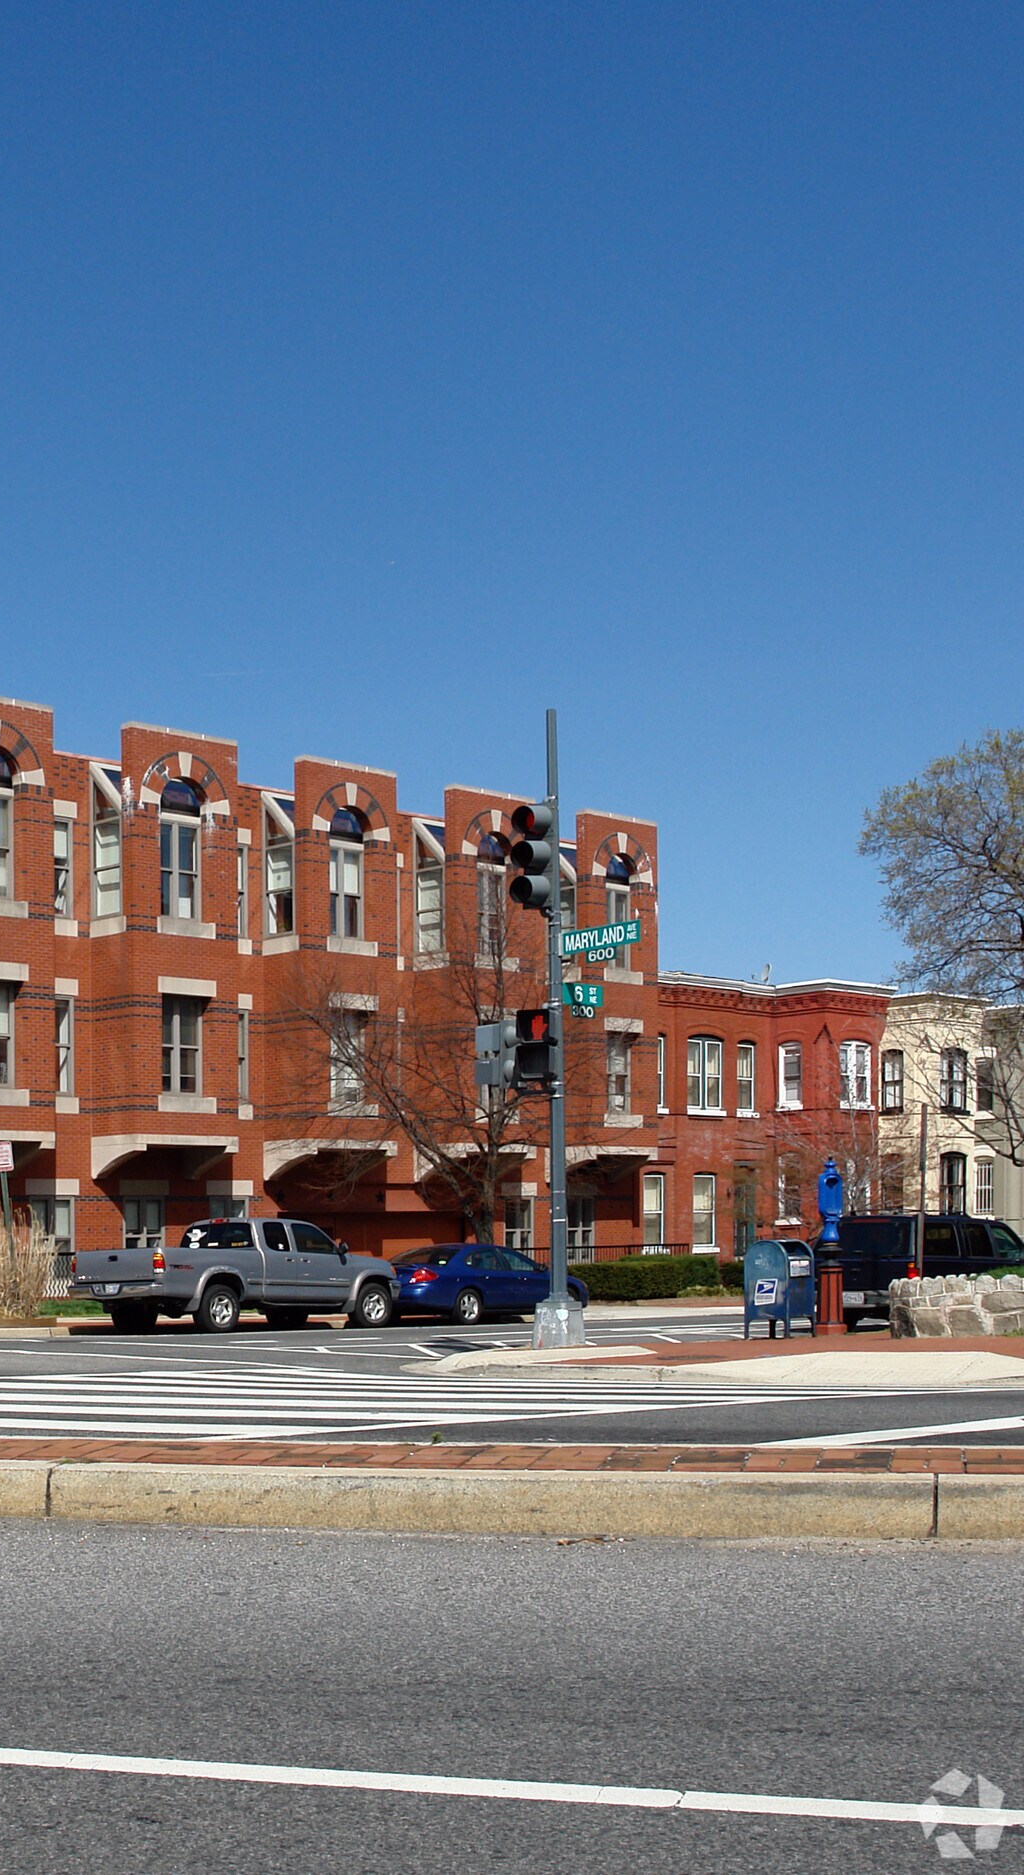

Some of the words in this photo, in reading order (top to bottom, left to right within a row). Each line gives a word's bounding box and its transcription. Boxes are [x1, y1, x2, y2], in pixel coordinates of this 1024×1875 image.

[565, 925, 625, 952] MARYLAND
[626, 923, 637, 932] AVE
[626, 931, 637, 940] NE
[588, 947, 615, 962] 600
[574, 985, 584, 1003] 6
[589, 987, 597, 995] ST
[589, 996, 598, 1004] NE
[572, 1005, 594, 1018] 300
